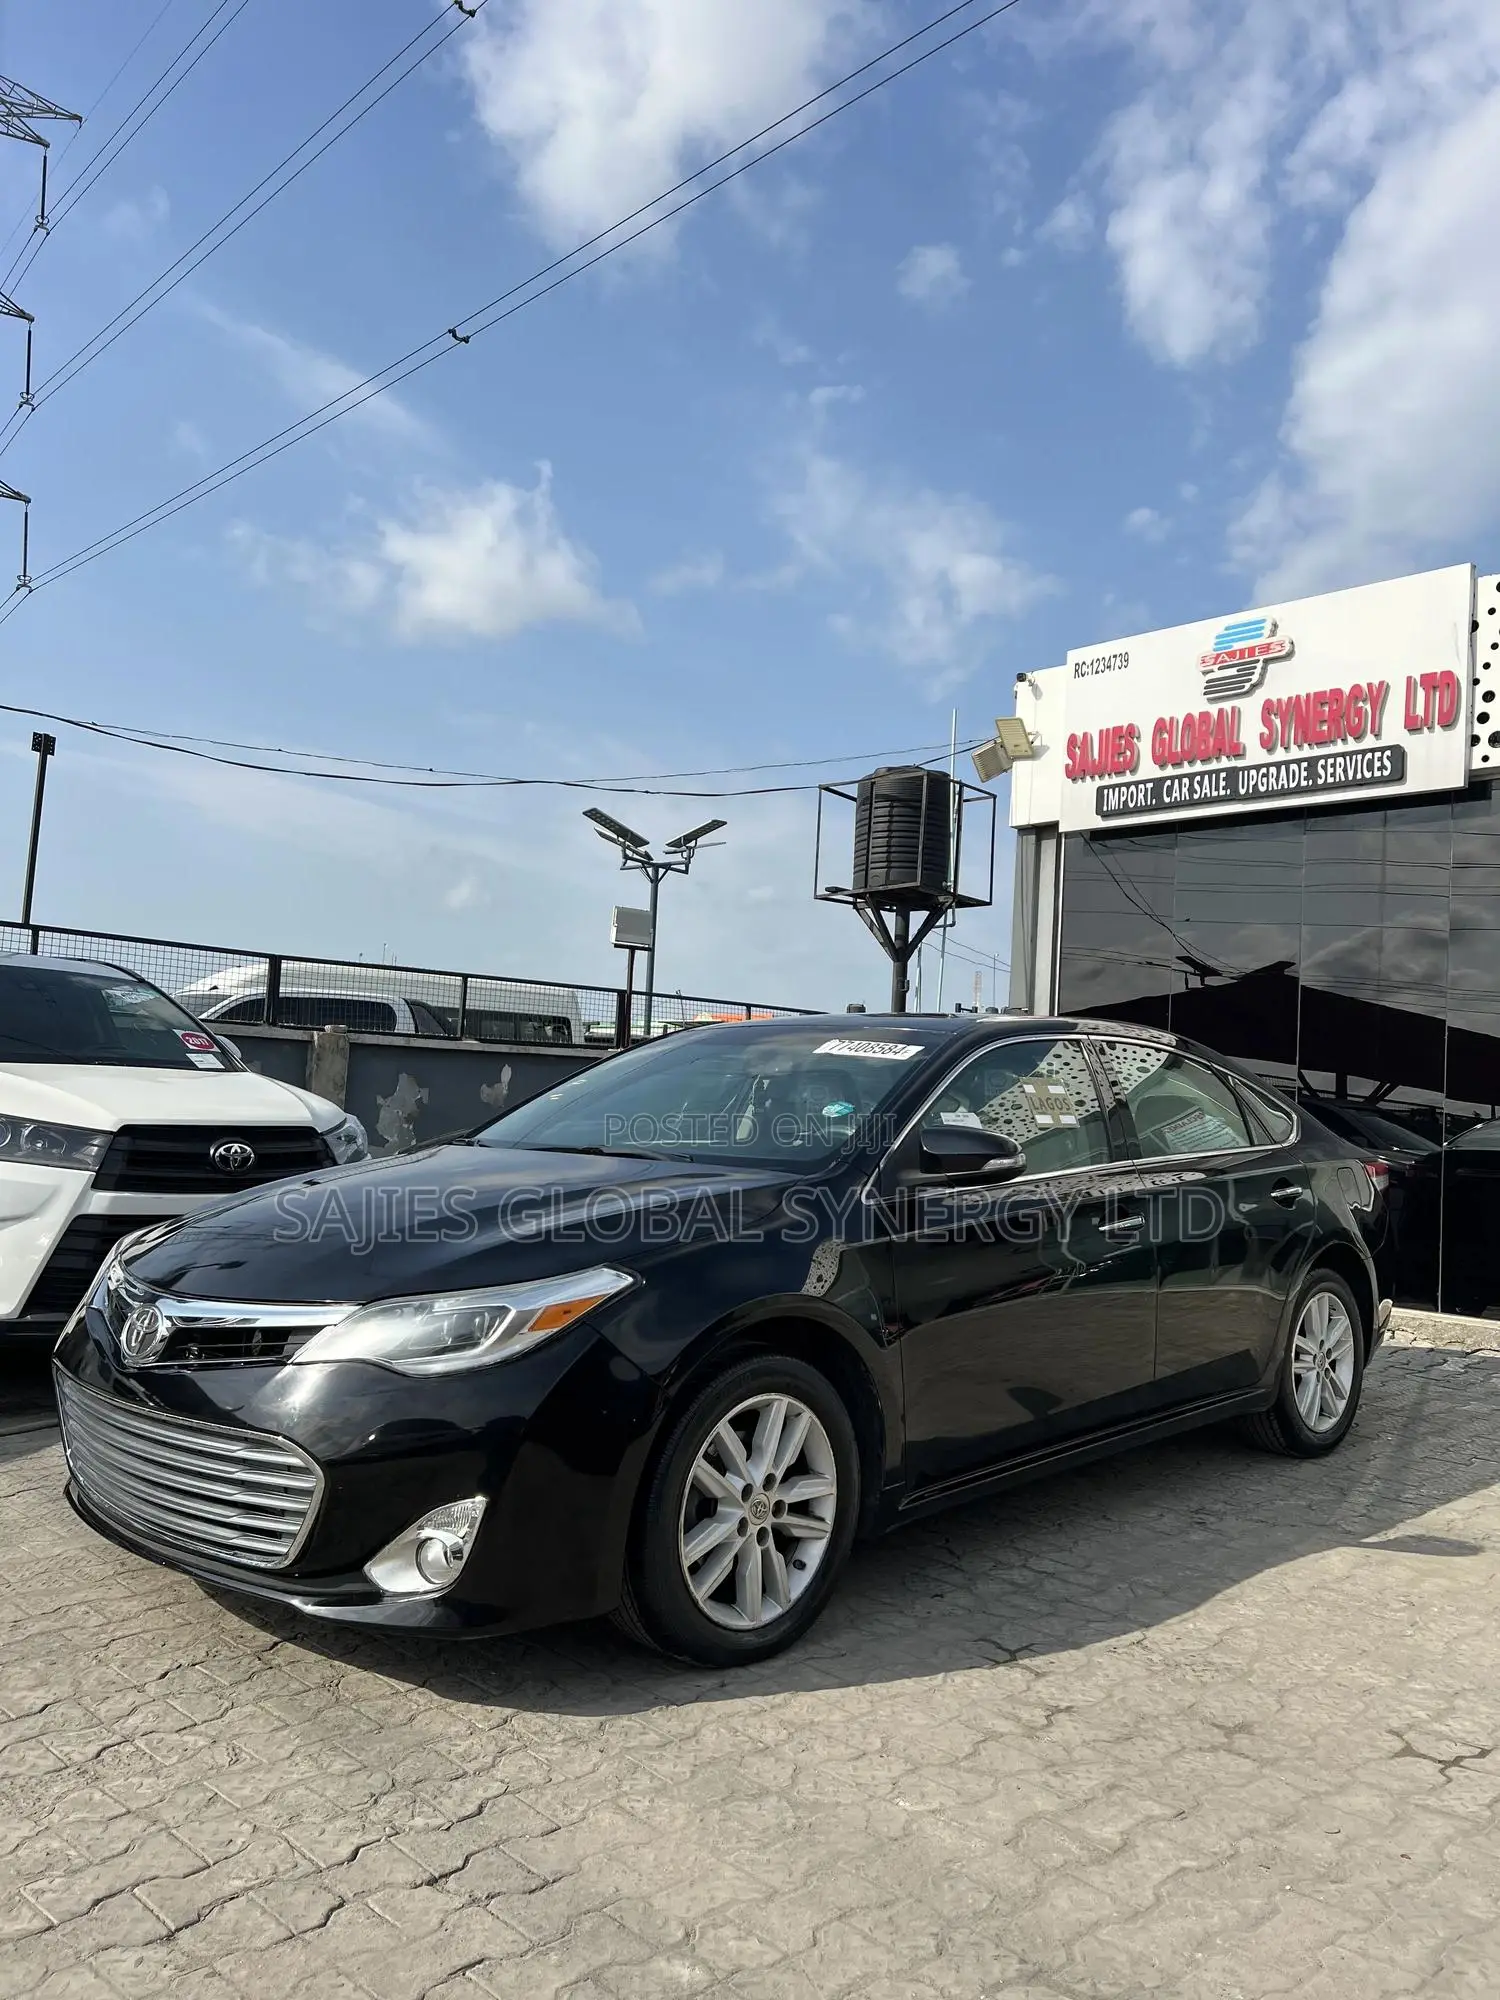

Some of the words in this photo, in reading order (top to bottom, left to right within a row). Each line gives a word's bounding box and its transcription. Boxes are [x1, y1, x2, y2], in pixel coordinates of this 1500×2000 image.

[1074, 651, 1130, 679] RC:1234739
[1200, 640, 1287, 668] SAJIES
[1065, 723, 1140, 780] SAJIES
[1152, 706, 1245, 767] GLOBAL
[1260, 680, 1388, 750] SYNERGY
[1404, 670, 1459, 731] LTD
[1103, 782, 1156, 812] IMPORT.
[1163, 778, 1190, 803] CAR
[1193, 771, 1231, 799] SALE.
[1238, 761, 1313, 795] UPGRADE.
[1317, 750, 1392, 785] SERVICES
[1030, 1096, 1071, 1111] LAGOS
